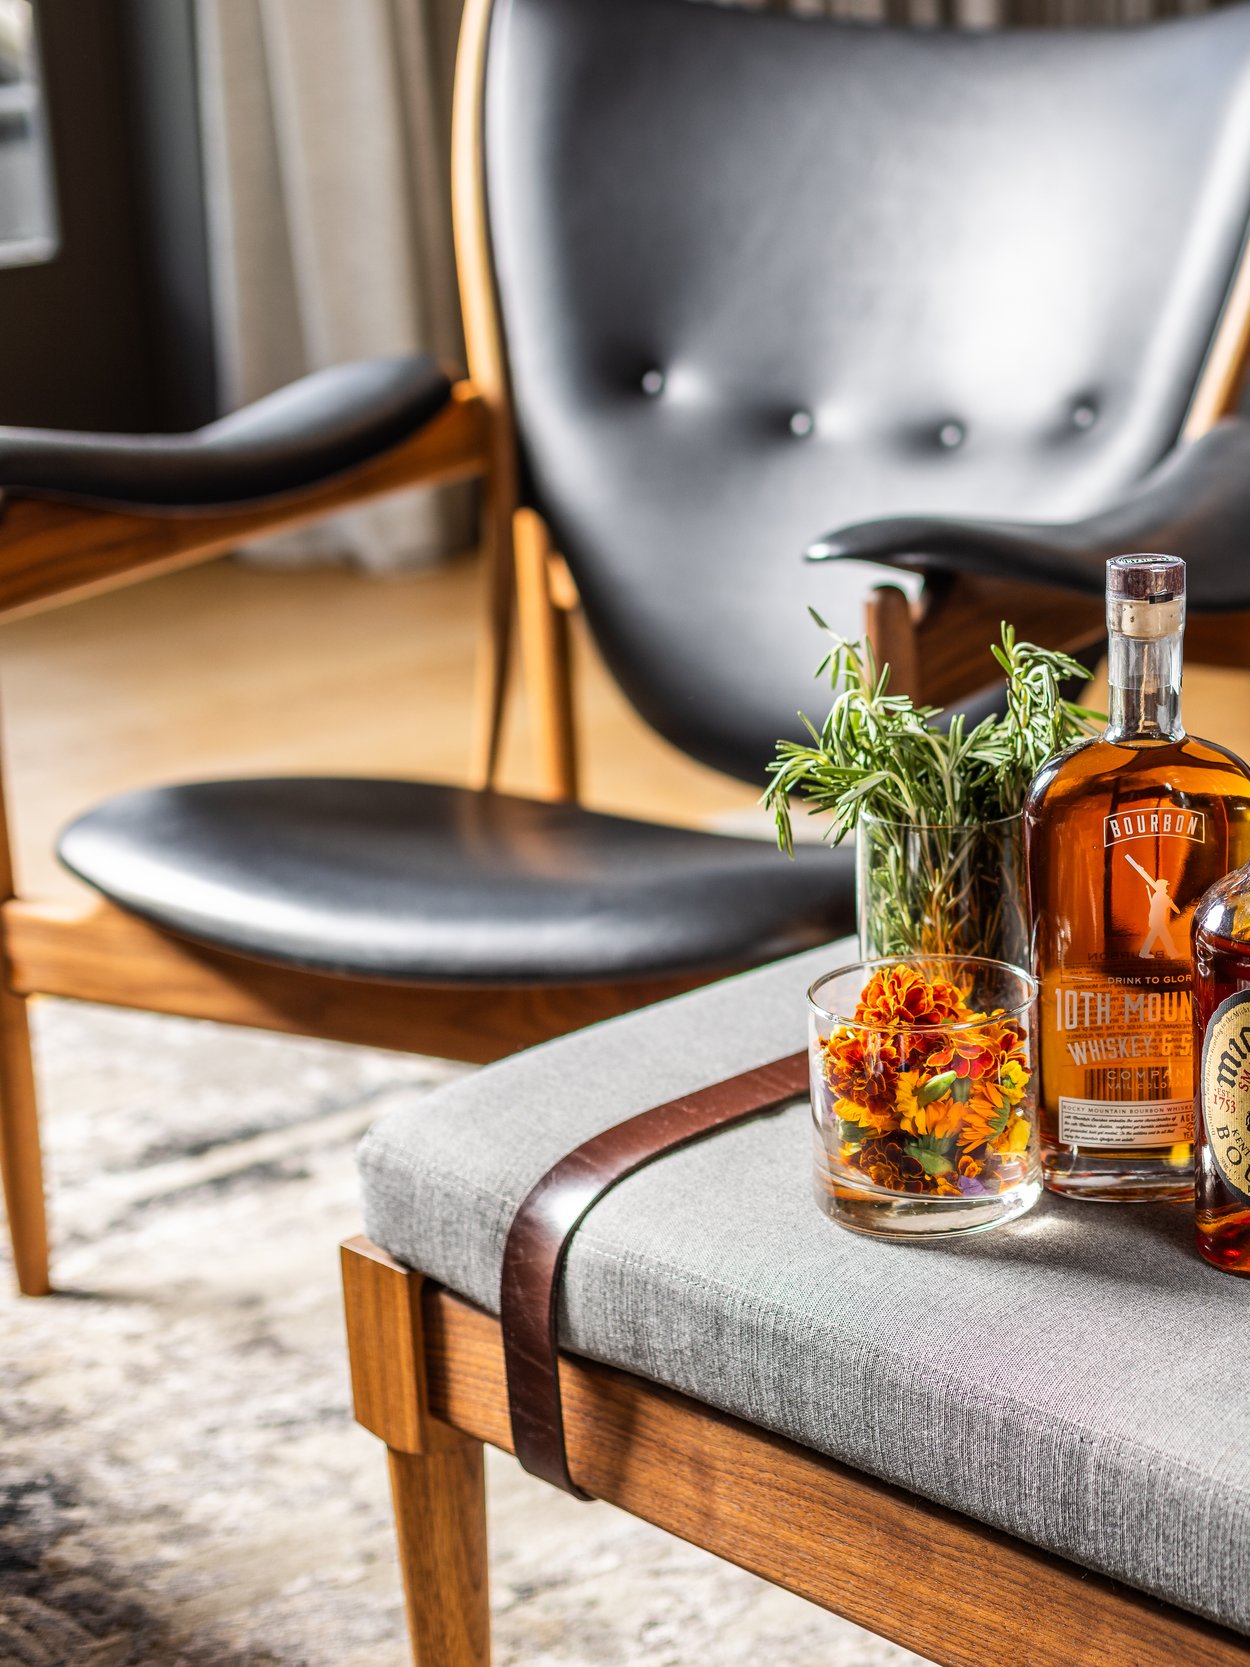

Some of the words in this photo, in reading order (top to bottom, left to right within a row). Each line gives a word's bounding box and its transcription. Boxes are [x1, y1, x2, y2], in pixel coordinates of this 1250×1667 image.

[1109, 814, 1198, 838] BOURBON
[1107, 976, 1142, 985] DRINK
[1145, 976, 1160, 984] TO
[1055, 988, 1110, 1032] 10TH
[1067, 1034, 1153, 1066] WHISKEY
[1180, 1033, 1192, 1056] S
[1063, 1104, 1085, 1112] ROCKY
[1213, 1094, 1236, 1114] 1753
